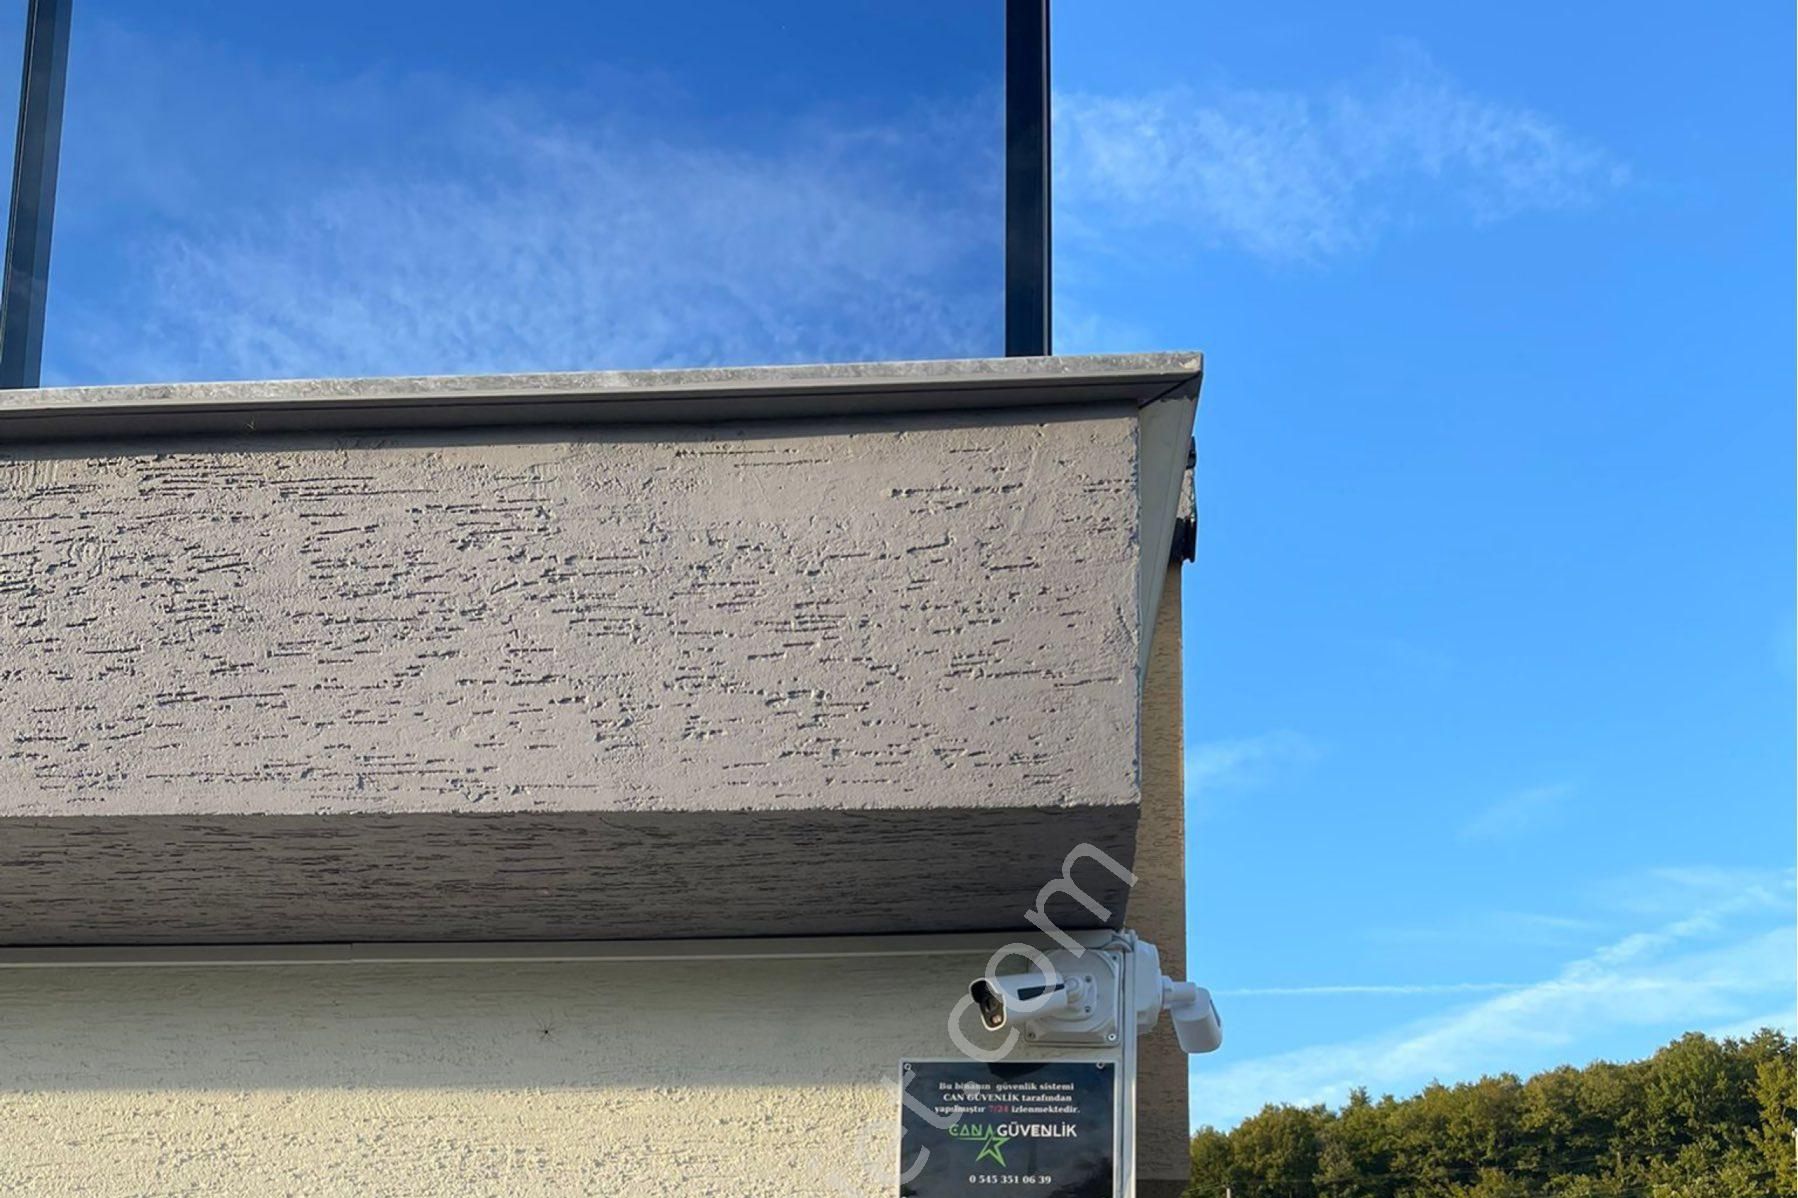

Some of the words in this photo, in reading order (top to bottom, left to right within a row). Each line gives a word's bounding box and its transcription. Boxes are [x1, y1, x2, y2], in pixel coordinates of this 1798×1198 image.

[939, 1082, 953, 1090] Bu
[996, 1082, 1038, 1092] güvenlik
[1039, 1082, 1074, 1090] sistemi
[943, 1093, 965, 1102] CAN
[1021, 1094, 1073, 1102] tarafından
[1011, 1105, 1081, 1113] izlenmektedir.
[948, 1123, 983, 1137] CAN
[996, 1121, 1078, 1138] GÜVENLİK
[968, 1174, 977, 1184] 0
[978, 1174, 998, 1184] 545
[1000, 1175, 1019, 1185] 351
[1022, 1175, 1036, 1184] 06
[1038, 1175, 1052, 1185] 39
